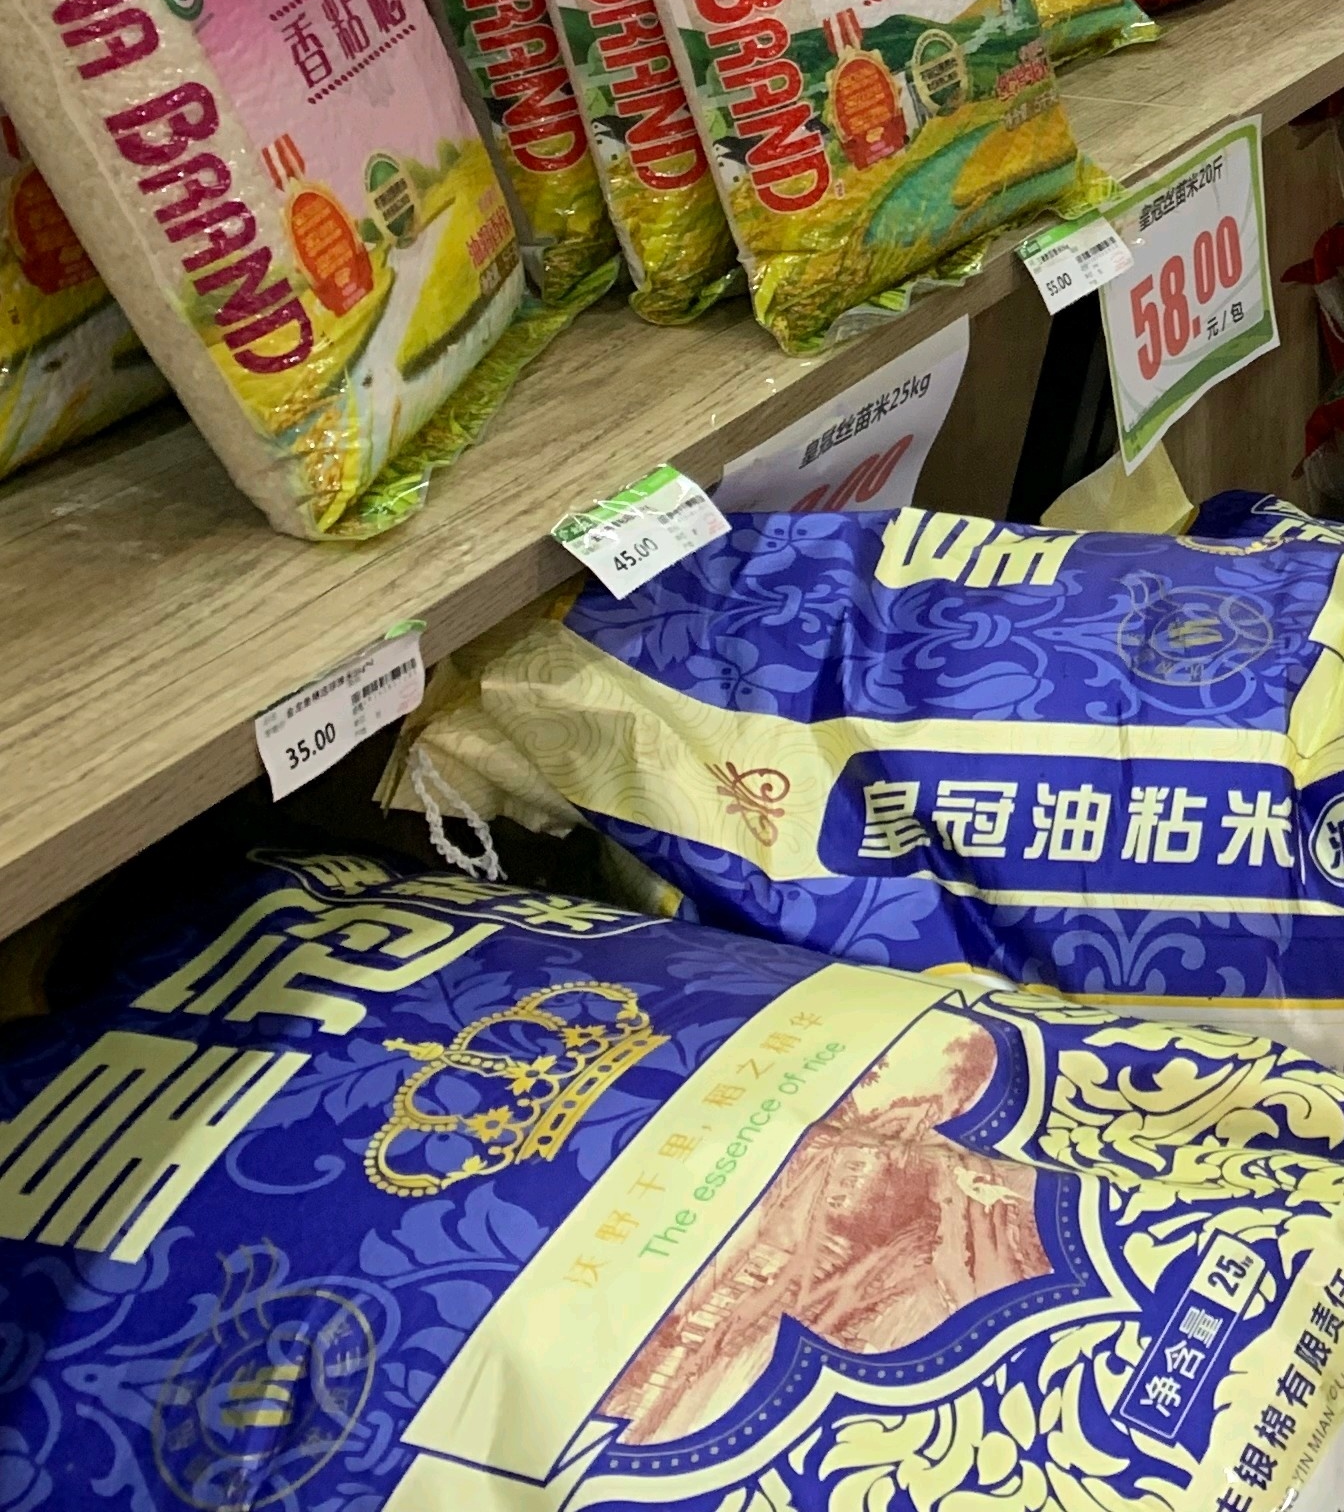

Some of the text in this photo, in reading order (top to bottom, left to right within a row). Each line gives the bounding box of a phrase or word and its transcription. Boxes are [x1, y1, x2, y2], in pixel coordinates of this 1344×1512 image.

[104, 80, 316, 375] BRAND
[1045, 272, 1073, 297] 55.00
[1129, 214, 1243, 381] 58.00
[1206, 300, 1245, 341] 元/包
[612, 536, 660, 574] 45.00
[285, 722, 337, 770] 35.00
[859, 776, 1298, 869] 皇冠油粘米
[637, 1041, 846, 1259] The essence of rice
[1139, 1305, 1224, 1419] 净含量
[1291, 1453, 1316, 1486] YIN
[1310, 1407, 1337, 1453] MIAN
